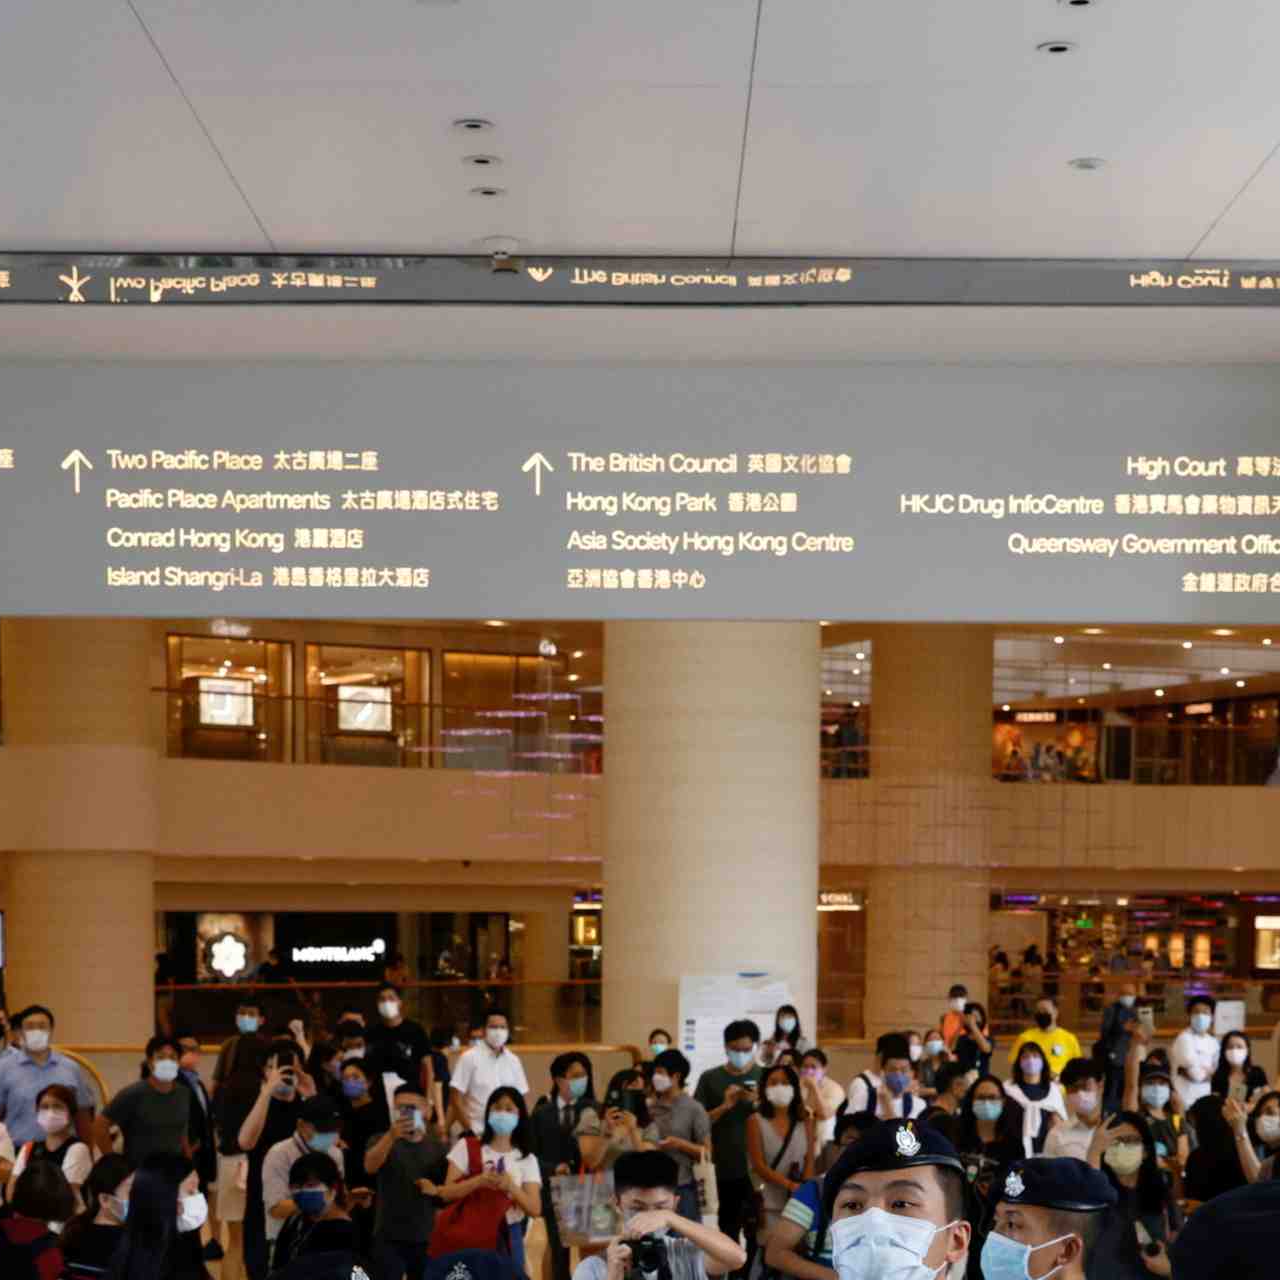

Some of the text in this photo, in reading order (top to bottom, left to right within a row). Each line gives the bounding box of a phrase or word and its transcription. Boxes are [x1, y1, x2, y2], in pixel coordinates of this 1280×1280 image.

[106, 449, 379, 471] Two Pacific Place 太古廣場二座
[567, 452, 852, 474] The British Council 英國文化協會
[1126, 455, 1171, 481] High
[1173, 455, 1227, 477] Court
[106, 488, 499, 513] Pacific Place Apartments 太古廣場酒店式住宅
[566, 491, 798, 517] Hong Kong Park 香港公園
[900, 493, 955, 514] HKJC
[958, 493, 1005, 519] Drug
[1008, 493, 1105, 515] InfoCentre
[106, 527, 364, 554] Conrad Hong Kong 港麗酒店
[566, 529, 855, 557] Asia Society Hong Kong Centre
[1007, 532, 1120, 558] Queensway
[1121, 533, 1238, 555] Government
[107, 566, 430, 592] Island Shangri-La 港島香格里拉大酒店
[567, 568, 706, 589] 亞洲協會香港中心
